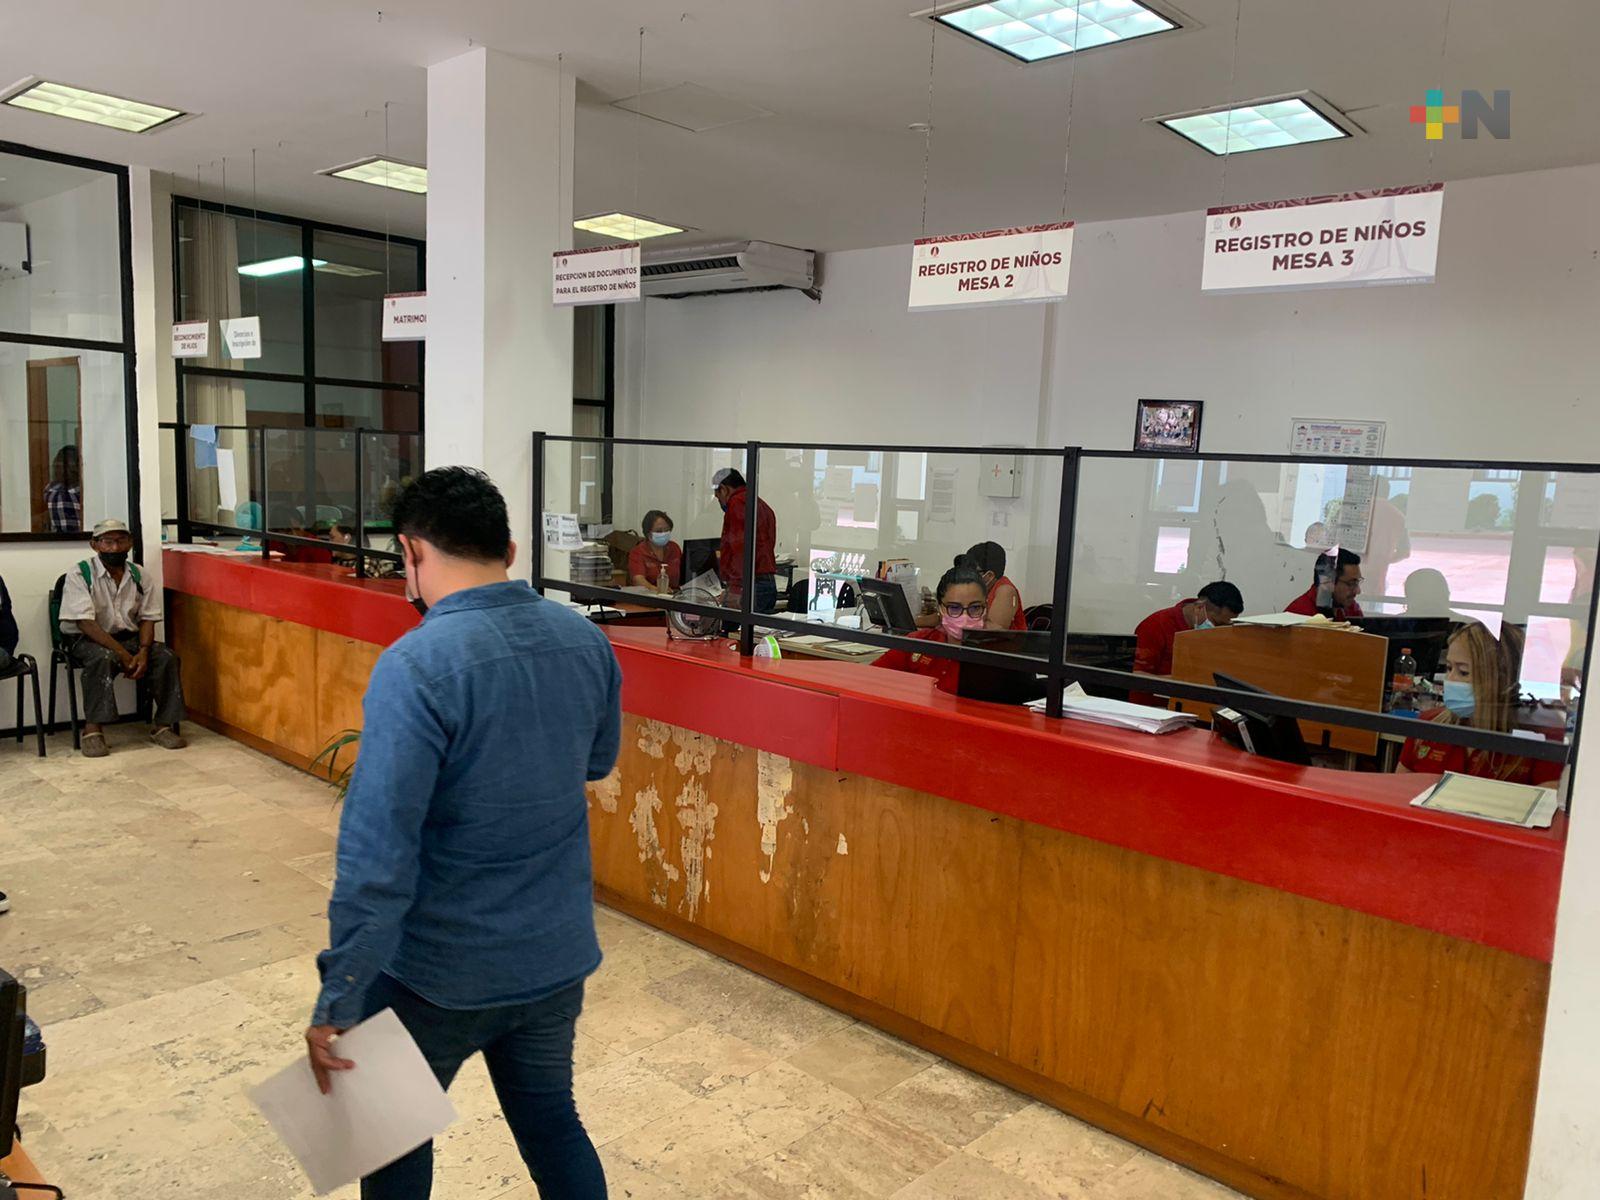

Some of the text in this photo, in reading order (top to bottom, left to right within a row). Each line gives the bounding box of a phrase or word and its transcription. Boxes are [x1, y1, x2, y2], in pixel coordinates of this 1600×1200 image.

[1214, 220, 1427, 254] REGISTRO DE NIÑOS
[918, 251, 1063, 277] REGISTRO DE NIÑOS
[1272, 249, 1355, 271] MESA 3
[556, 272, 586, 280] RECEPCION
[597, 267, 637, 278] DOCUMENTOS
[958, 274, 1014, 292] MESA 2
[580, 284, 608, 293] REGISTRO
[618, 280, 636, 290] NIÑOS
